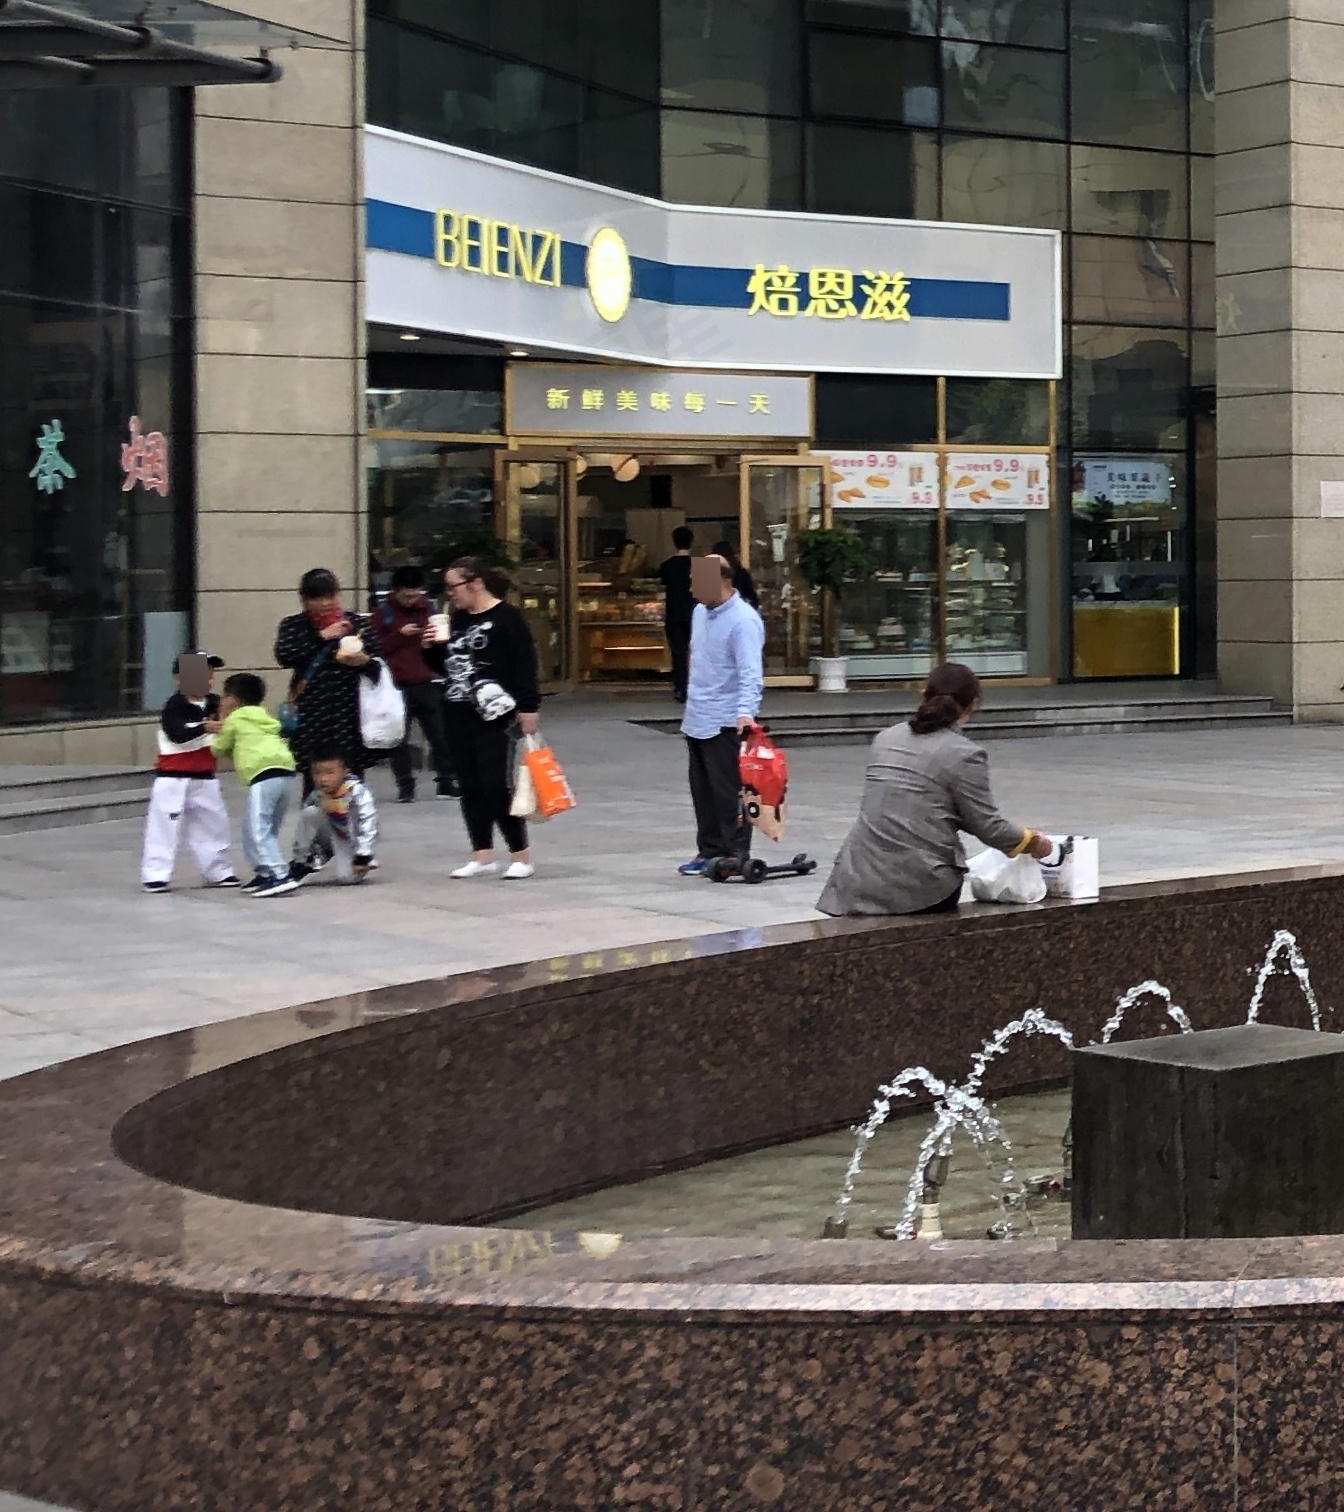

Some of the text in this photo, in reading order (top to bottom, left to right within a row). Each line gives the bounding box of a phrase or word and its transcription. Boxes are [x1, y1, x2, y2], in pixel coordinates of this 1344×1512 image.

[435, 208, 562, 288] BEIENZI
[746, 263, 912, 322] 焙恩滋
[546, 388, 770, 415] 新鲜美味每一天
